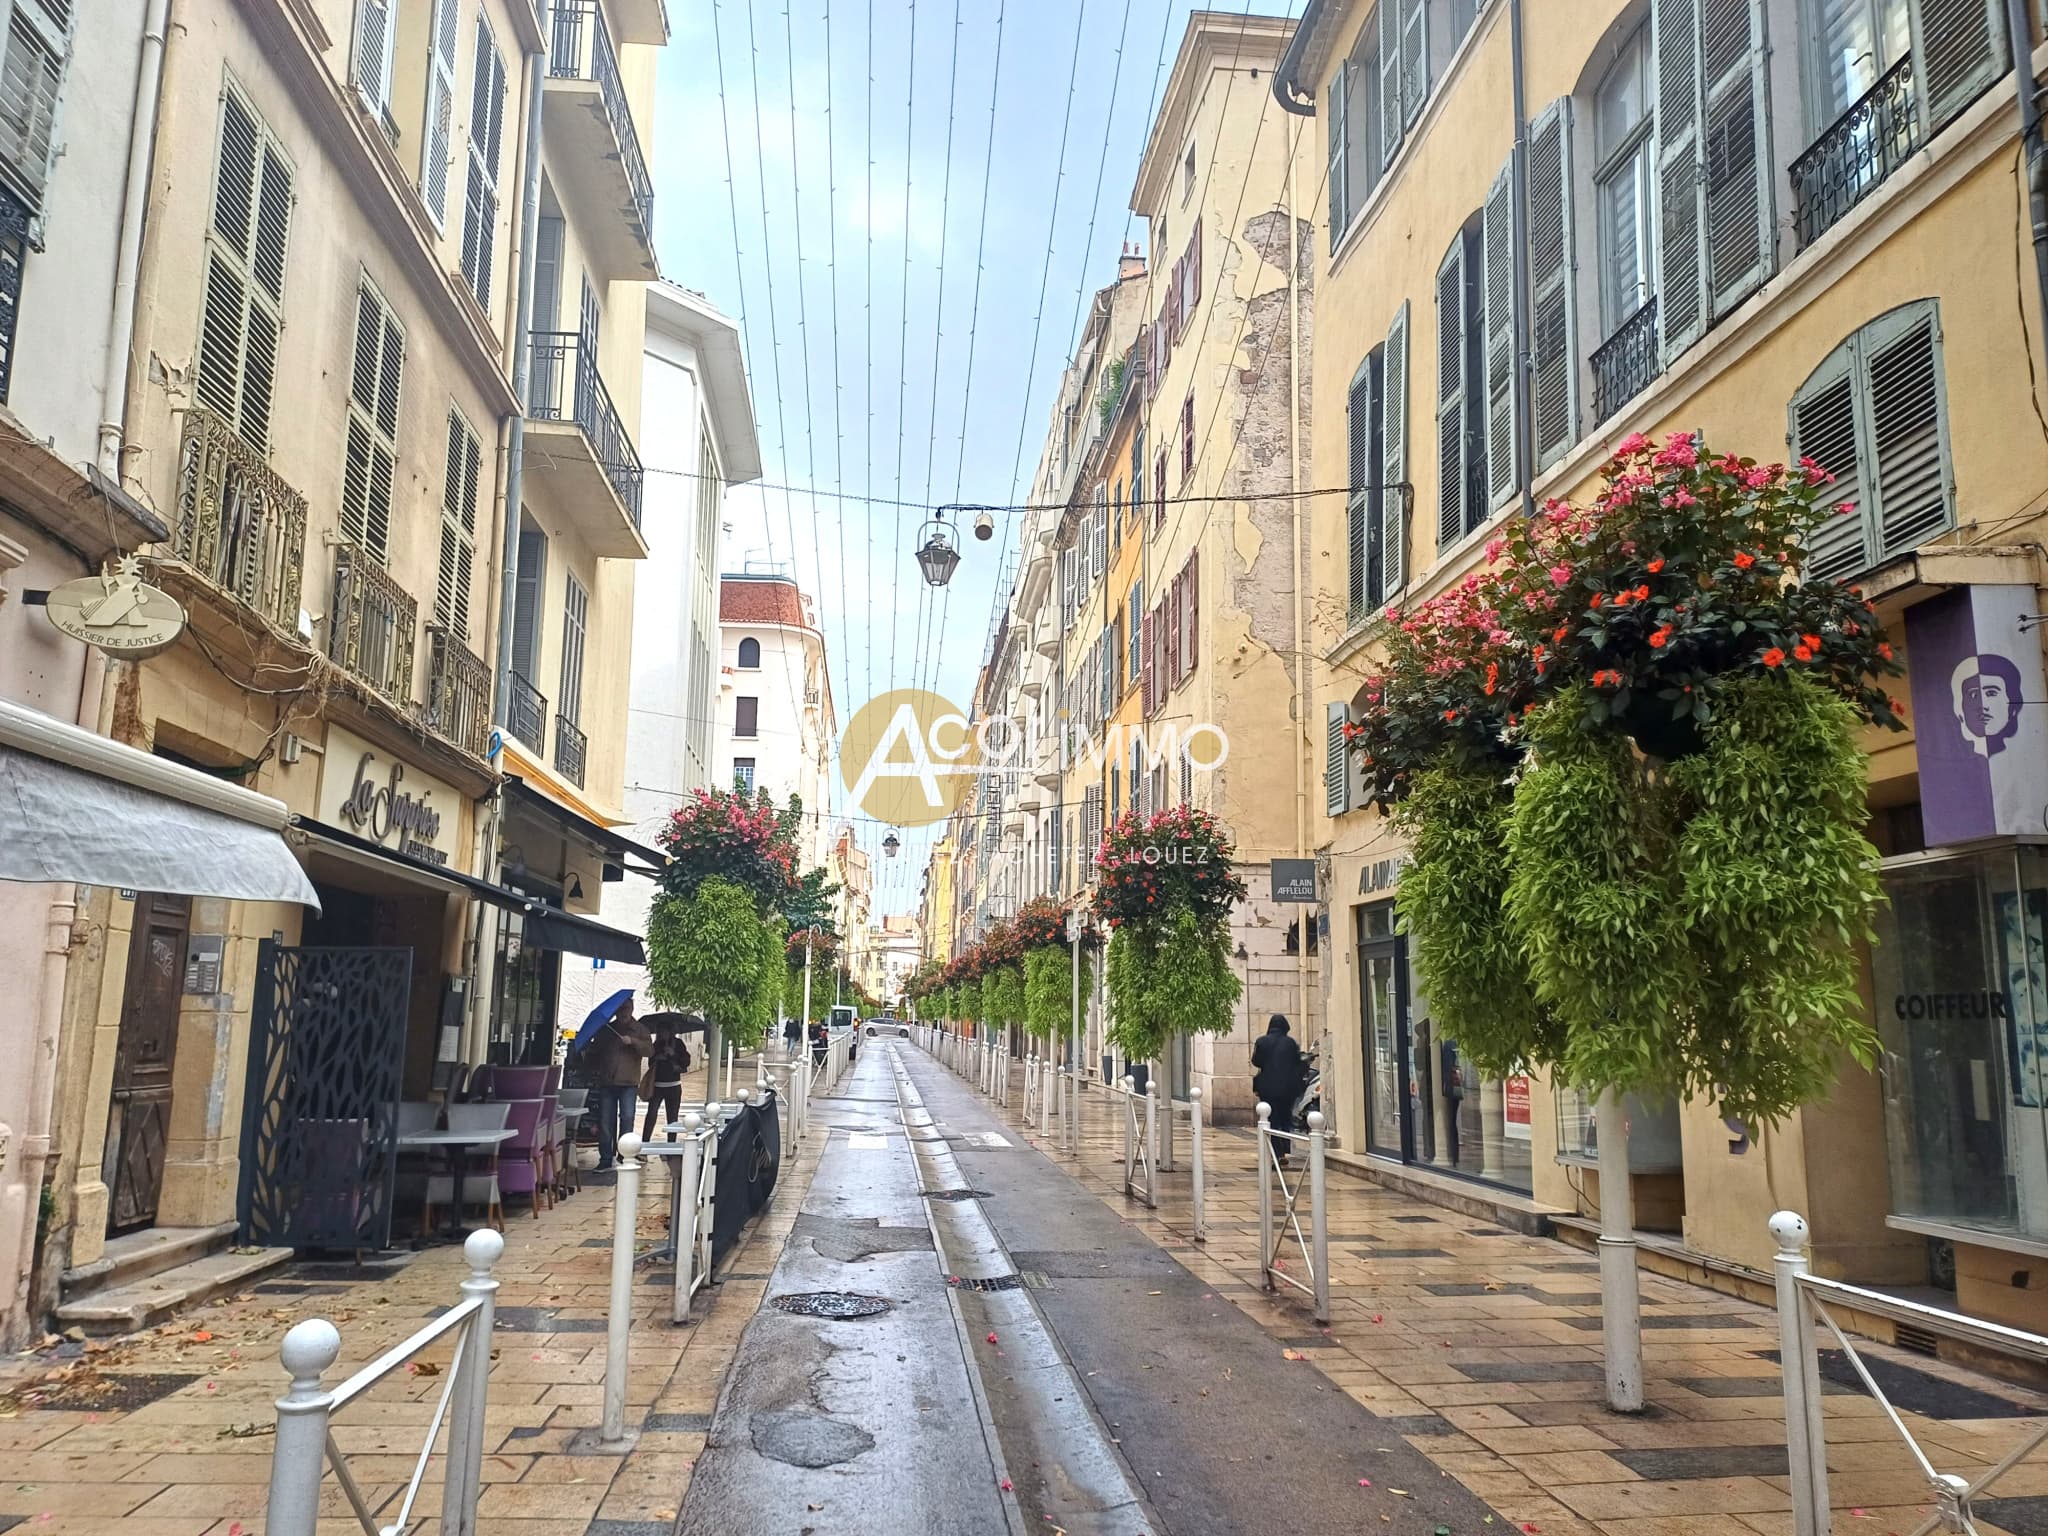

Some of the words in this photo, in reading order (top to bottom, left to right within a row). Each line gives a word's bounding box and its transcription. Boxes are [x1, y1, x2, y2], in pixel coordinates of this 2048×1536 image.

[62, 620, 105, 644] HUISSIER
[106, 637, 121, 646] DE
[125, 633, 165, 647] JUSTICE
[1277, 887, 1313, 895] AFFLELOU
[1358, 859, 1390, 895] ALAIN
[1895, 991, 2008, 1020] COIFFEUR
